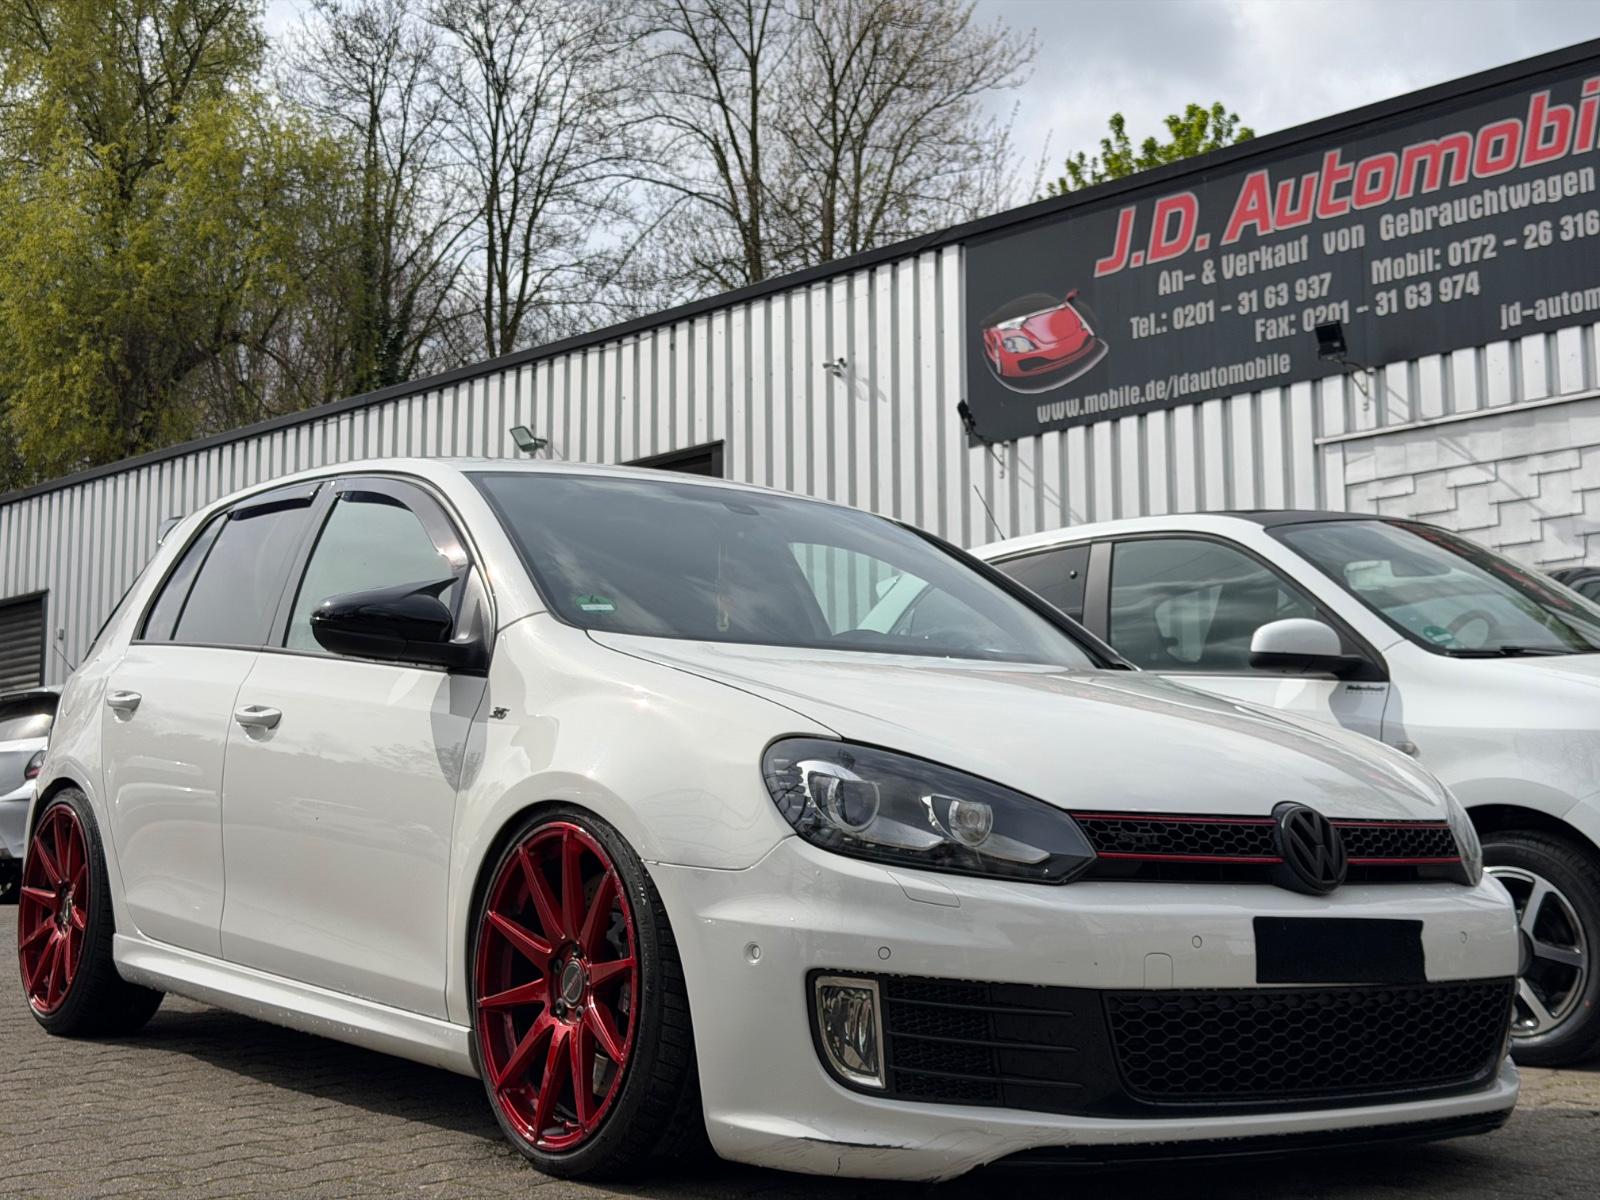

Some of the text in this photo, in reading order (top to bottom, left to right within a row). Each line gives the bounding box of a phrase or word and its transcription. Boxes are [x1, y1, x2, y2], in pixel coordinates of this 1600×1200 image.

[1094, 75, 1600, 278] J.D. Automobi
[1158, 166, 1596, 296] An- & Verkauf von Gebrauchtwagen
[1371, 247, 1442, 285] Mobil:
[1447, 233, 1498, 267] 0172
[1523, 220, 1553, 250] 26
[1559, 209, 1600, 241] 316
[1130, 312, 1168, 339] Tel.:
[1172, 299, 1215, 330] 0201
[1237, 288, 1259, 315] 31
[1263, 282, 1289, 309] 63
[1294, 271, 1333, 302] 937
[1255, 313, 1297, 343] Fax:
[1301, 299, 1350, 332] 0201
[1375, 288, 1398, 316] 31
[1404, 281, 1432, 310] 63
[1439, 270, 1481, 303] 974
[1037, 353, 1292, 424] www.mobile.de/jdautomobile
